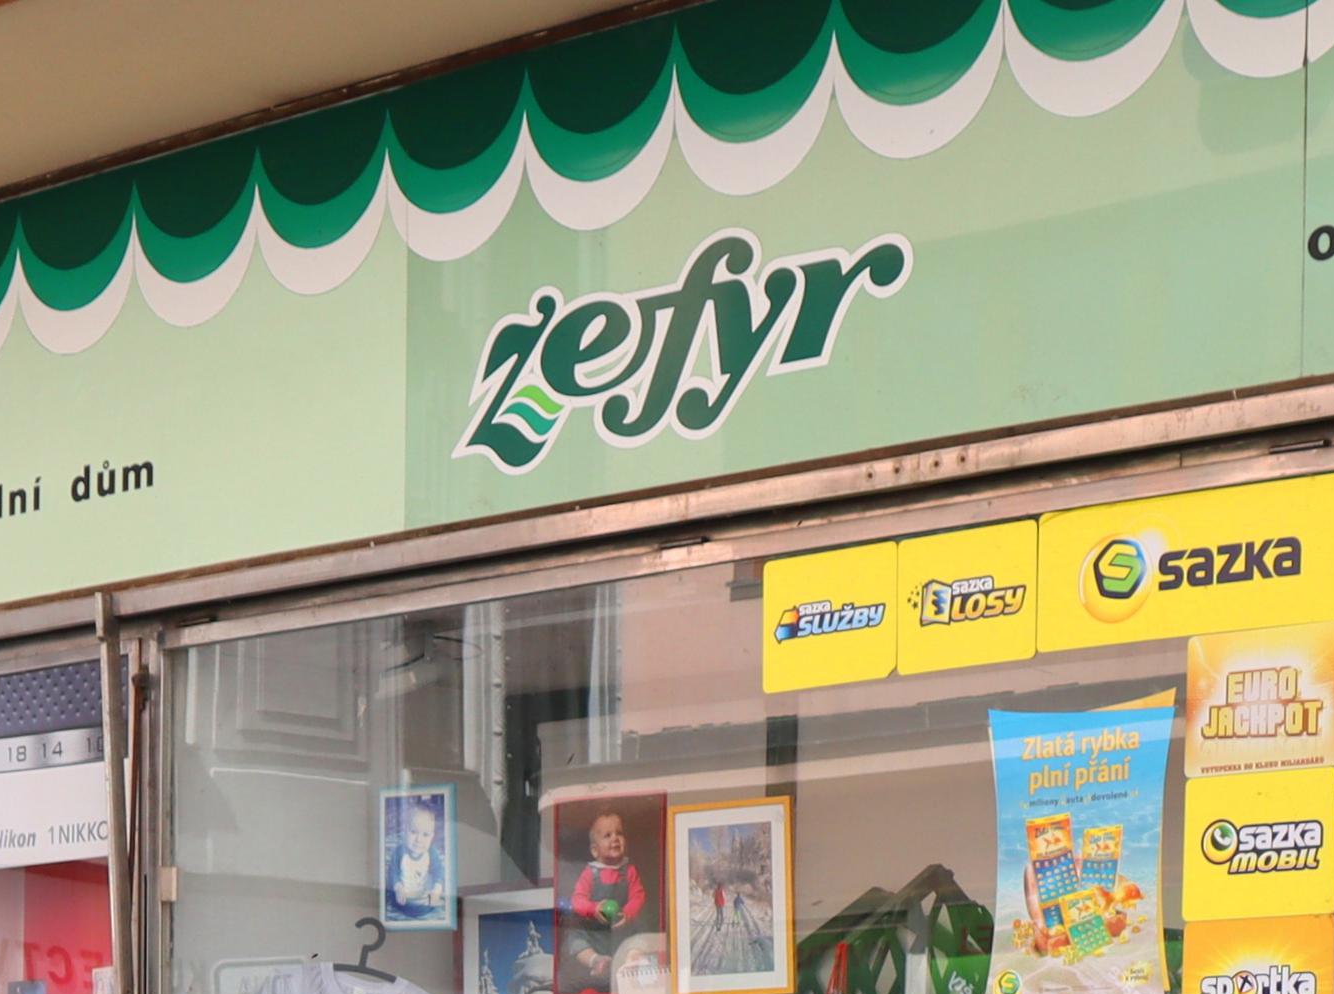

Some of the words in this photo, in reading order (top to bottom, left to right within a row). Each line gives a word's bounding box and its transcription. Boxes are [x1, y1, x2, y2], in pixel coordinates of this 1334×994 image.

[69, 455, 156, 504] dům
[797, 602, 886, 638] SLUŽBY
[950, 583, 1028, 622] LOSY
[1226, 667, 1301, 705] EURO
[1201, 700, 1324, 739] JACKPOT
[8, 745, 27, 763] 18
[42, 741, 63, 758] 14
[1020, 731, 1076, 762] Zlatá
[1080, 726, 1141, 759] rybka
[1027, 762, 1071, 797] plní
[1073, 755, 1132, 793] přání
[1227, 847, 1321, 875] MOBIL
